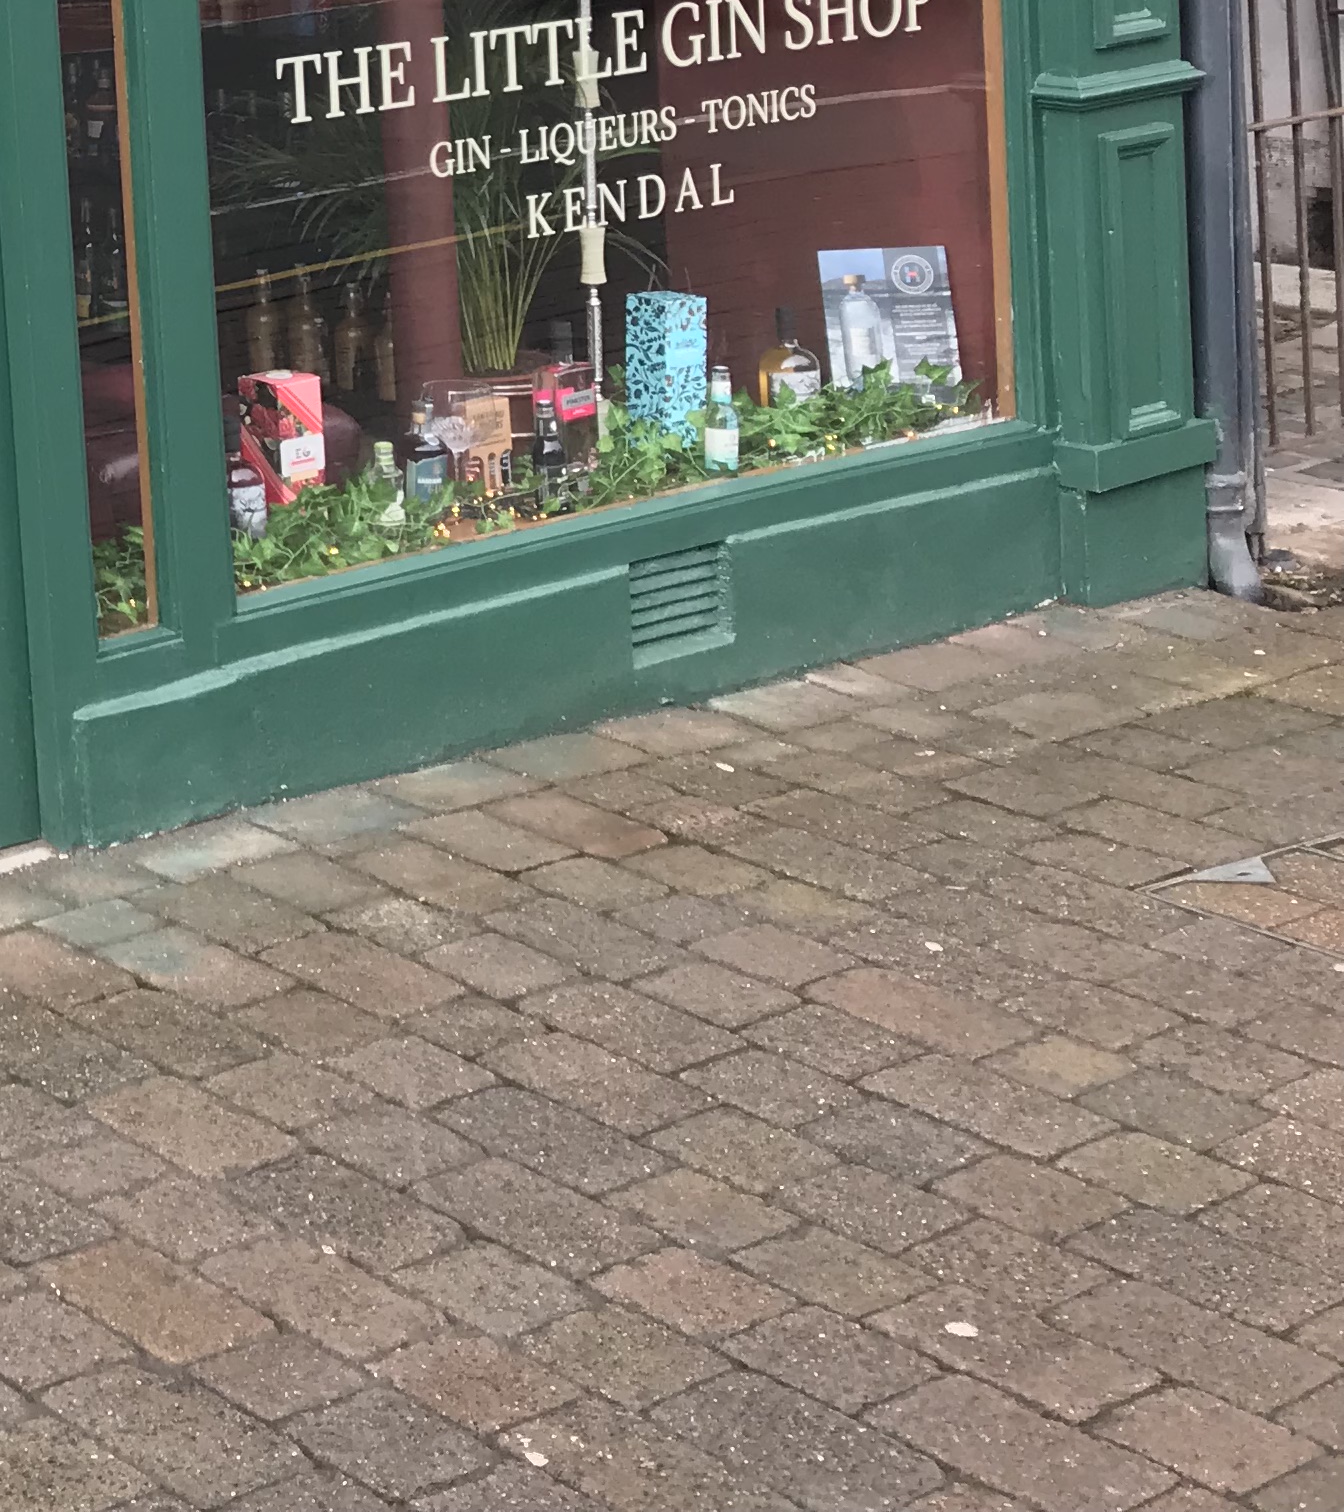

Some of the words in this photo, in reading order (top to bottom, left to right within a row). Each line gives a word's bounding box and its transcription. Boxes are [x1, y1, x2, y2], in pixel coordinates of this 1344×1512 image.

[276, 39, 414, 125] THE
[430, 9, 648, 104] LITTLE
[429, 133, 491, 179] GIN
[518, 105, 677, 167] LIQUEURS
[701, 84, 817, 135] TONICS
[526, 163, 735, 239] KENDAL
